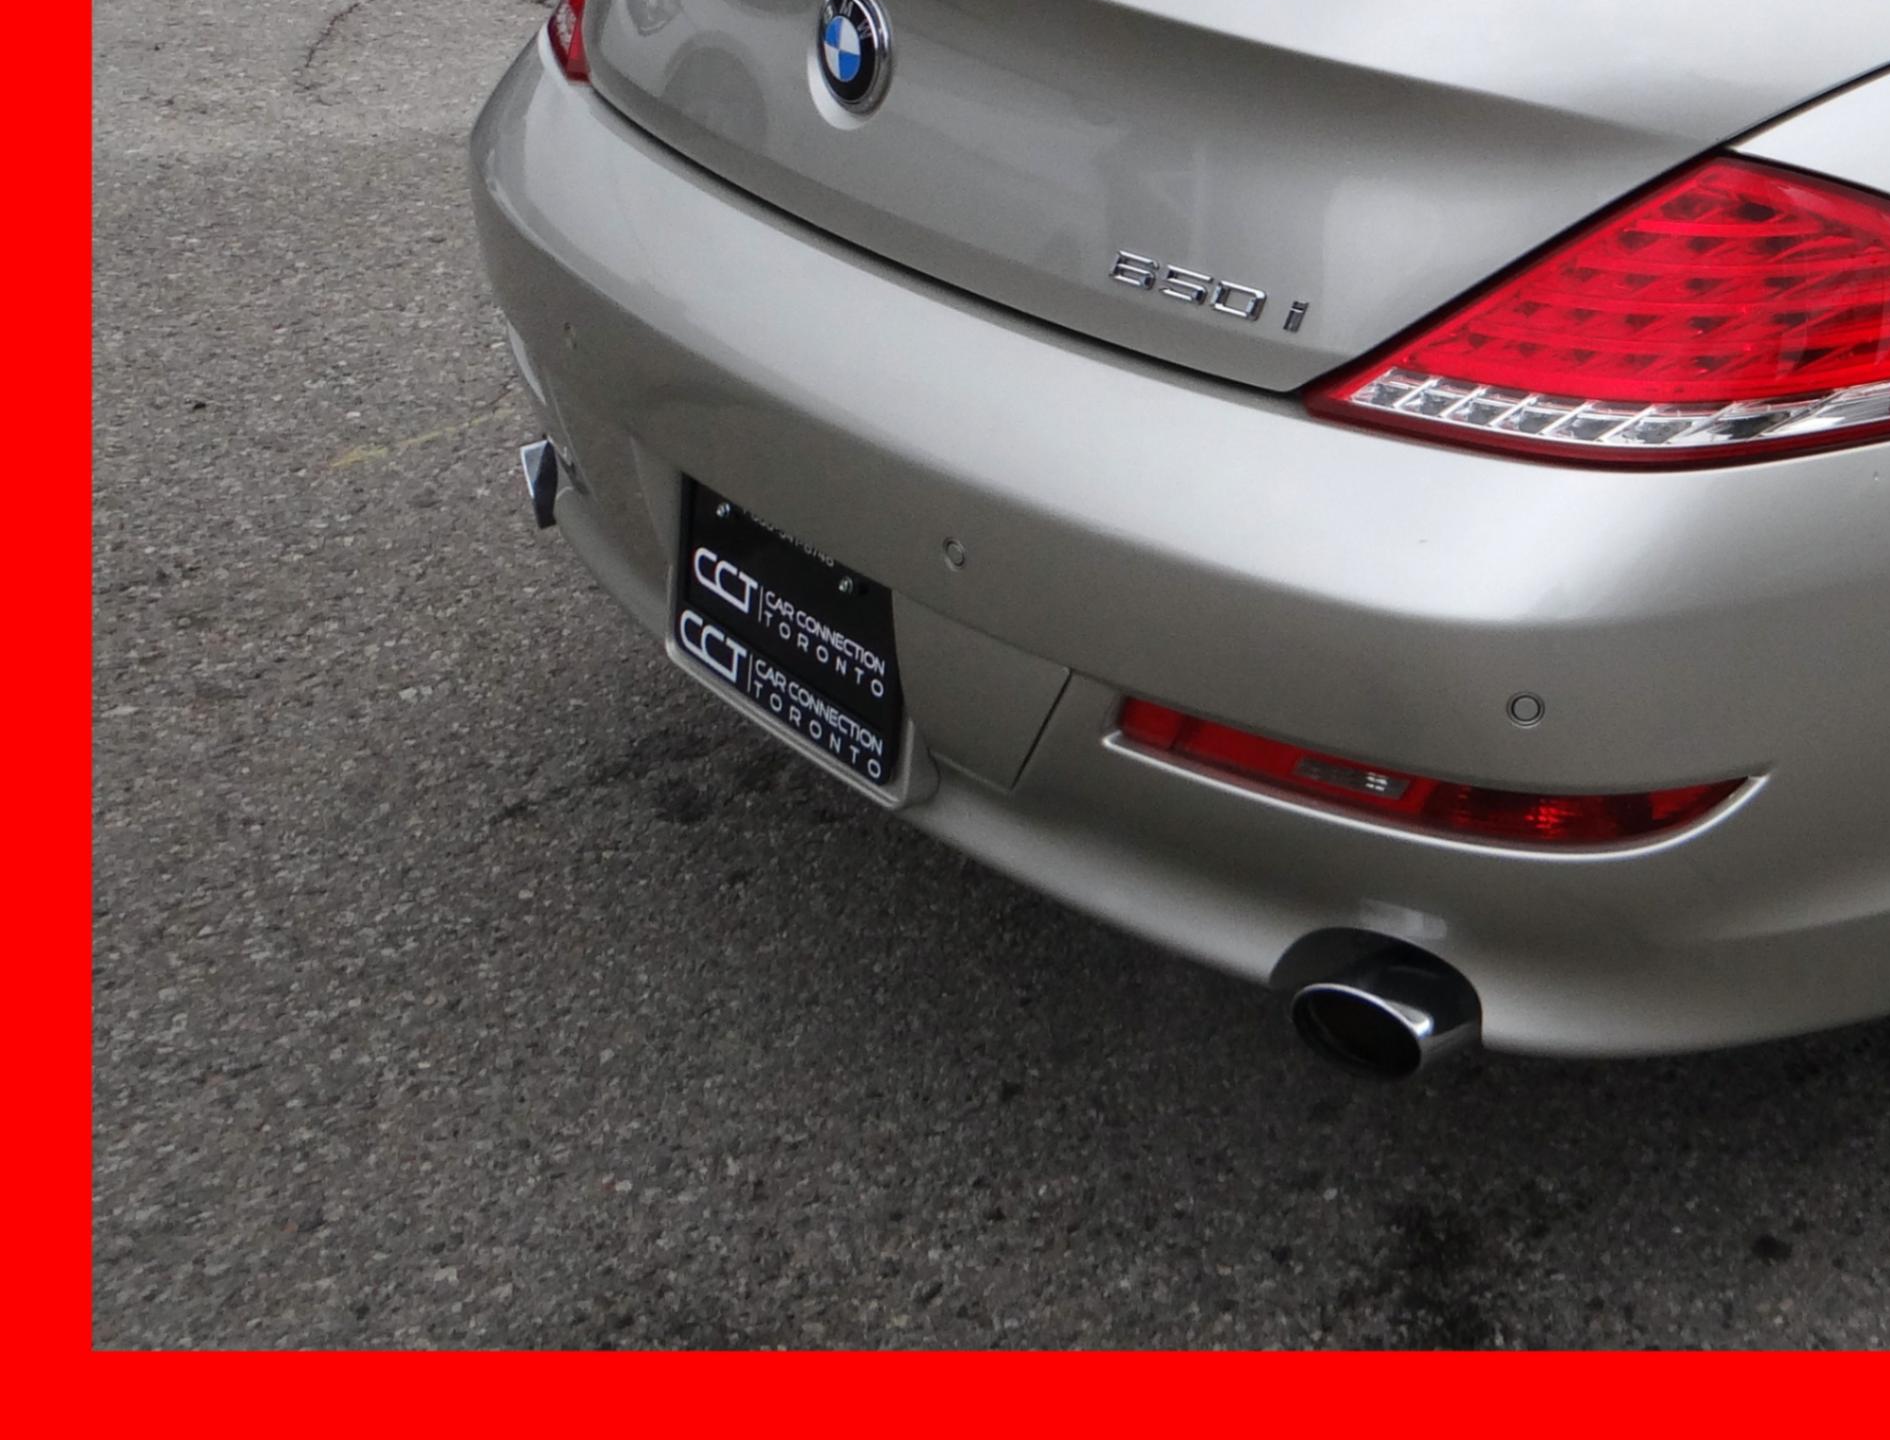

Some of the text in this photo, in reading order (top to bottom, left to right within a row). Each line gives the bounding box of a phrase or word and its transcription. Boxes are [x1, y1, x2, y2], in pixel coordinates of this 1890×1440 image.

[693, 547, 886, 676] CCT CAR CONNECTION
[763, 612, 884, 698] TORONTO
[680, 609, 883, 756] CCT CAR CONNECTION
[753, 680, 882, 779] TORONTO
